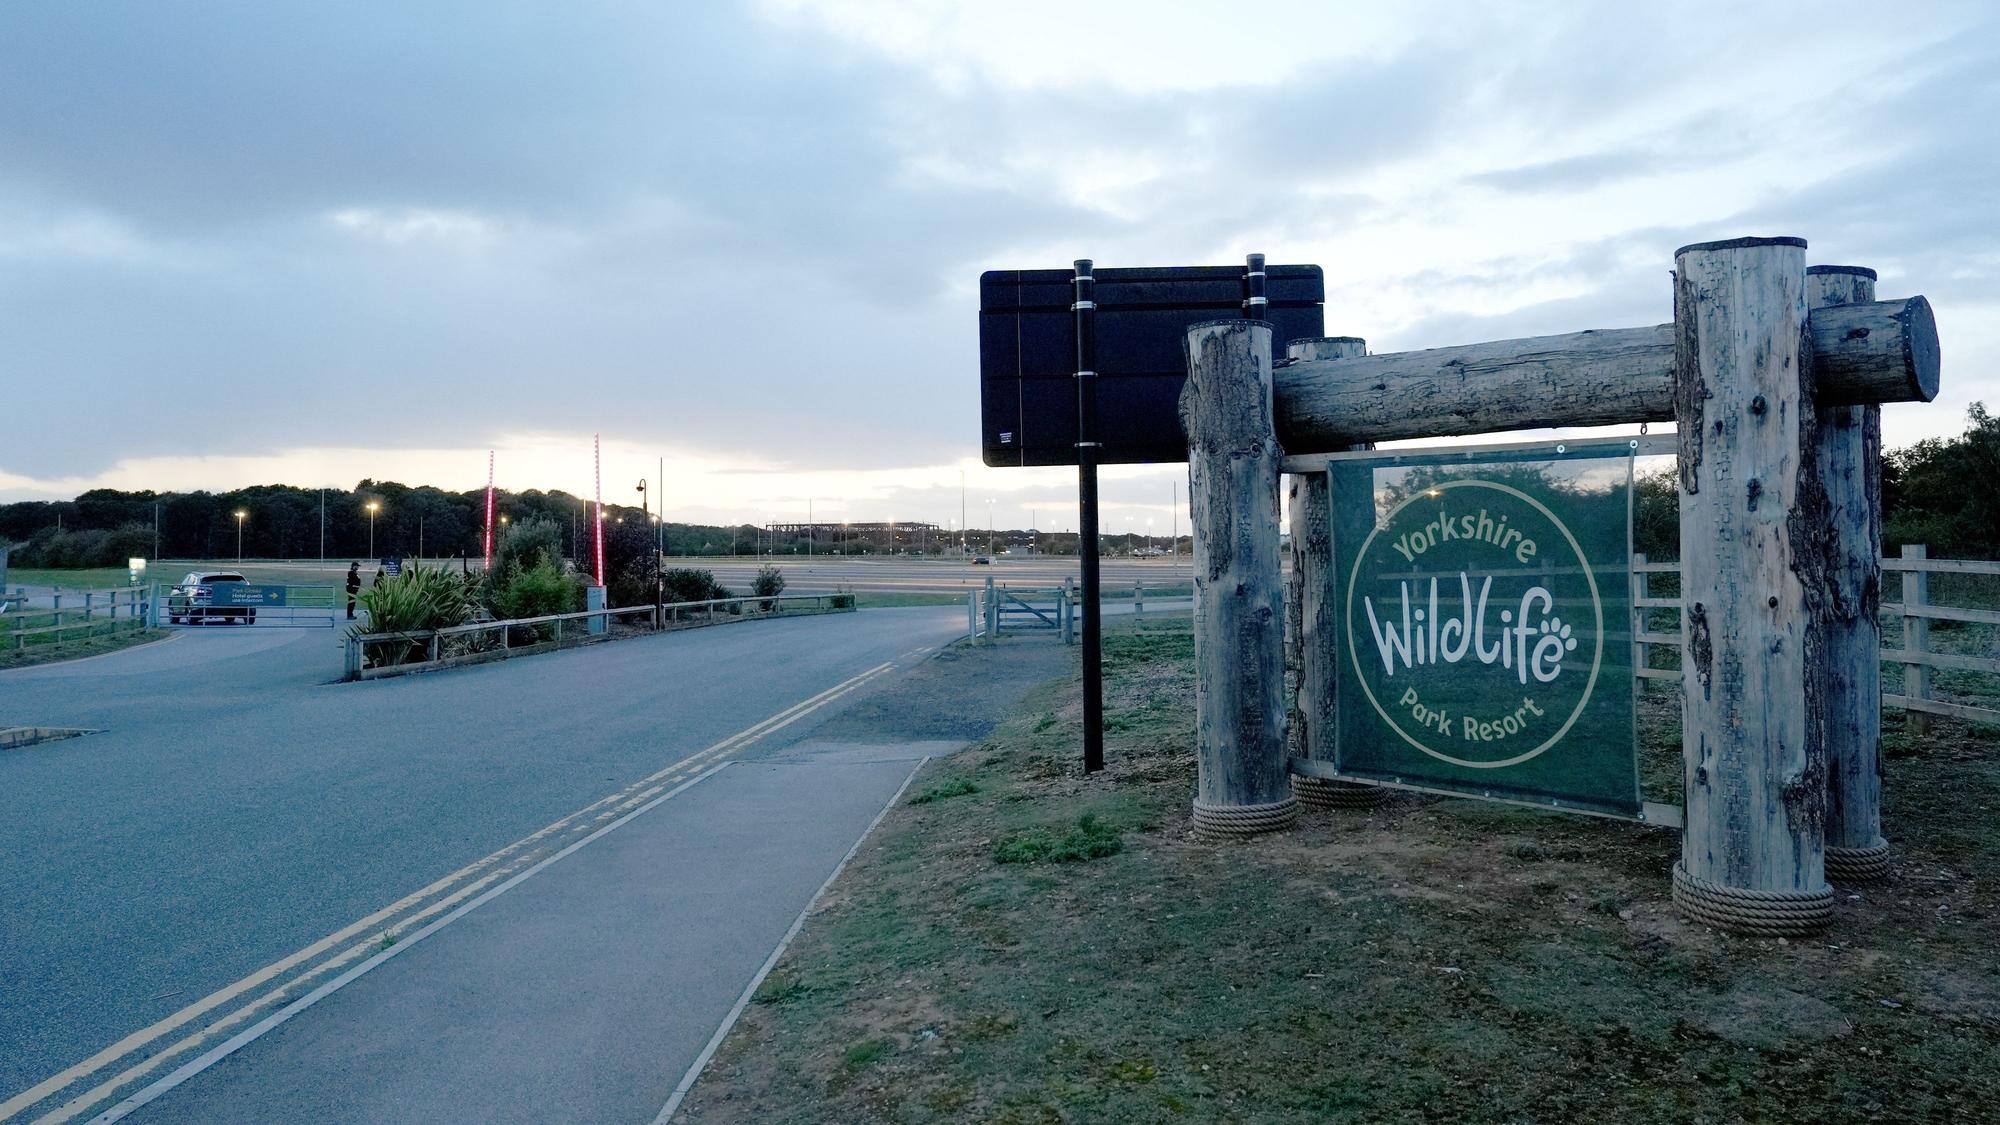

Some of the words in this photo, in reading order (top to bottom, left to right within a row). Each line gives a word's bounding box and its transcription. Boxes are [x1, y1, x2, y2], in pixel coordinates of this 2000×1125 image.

[1393, 508, 1537, 564] Yorkshire
[1399, 686, 1452, 737] Park
[1463, 696, 1545, 742] Resort
